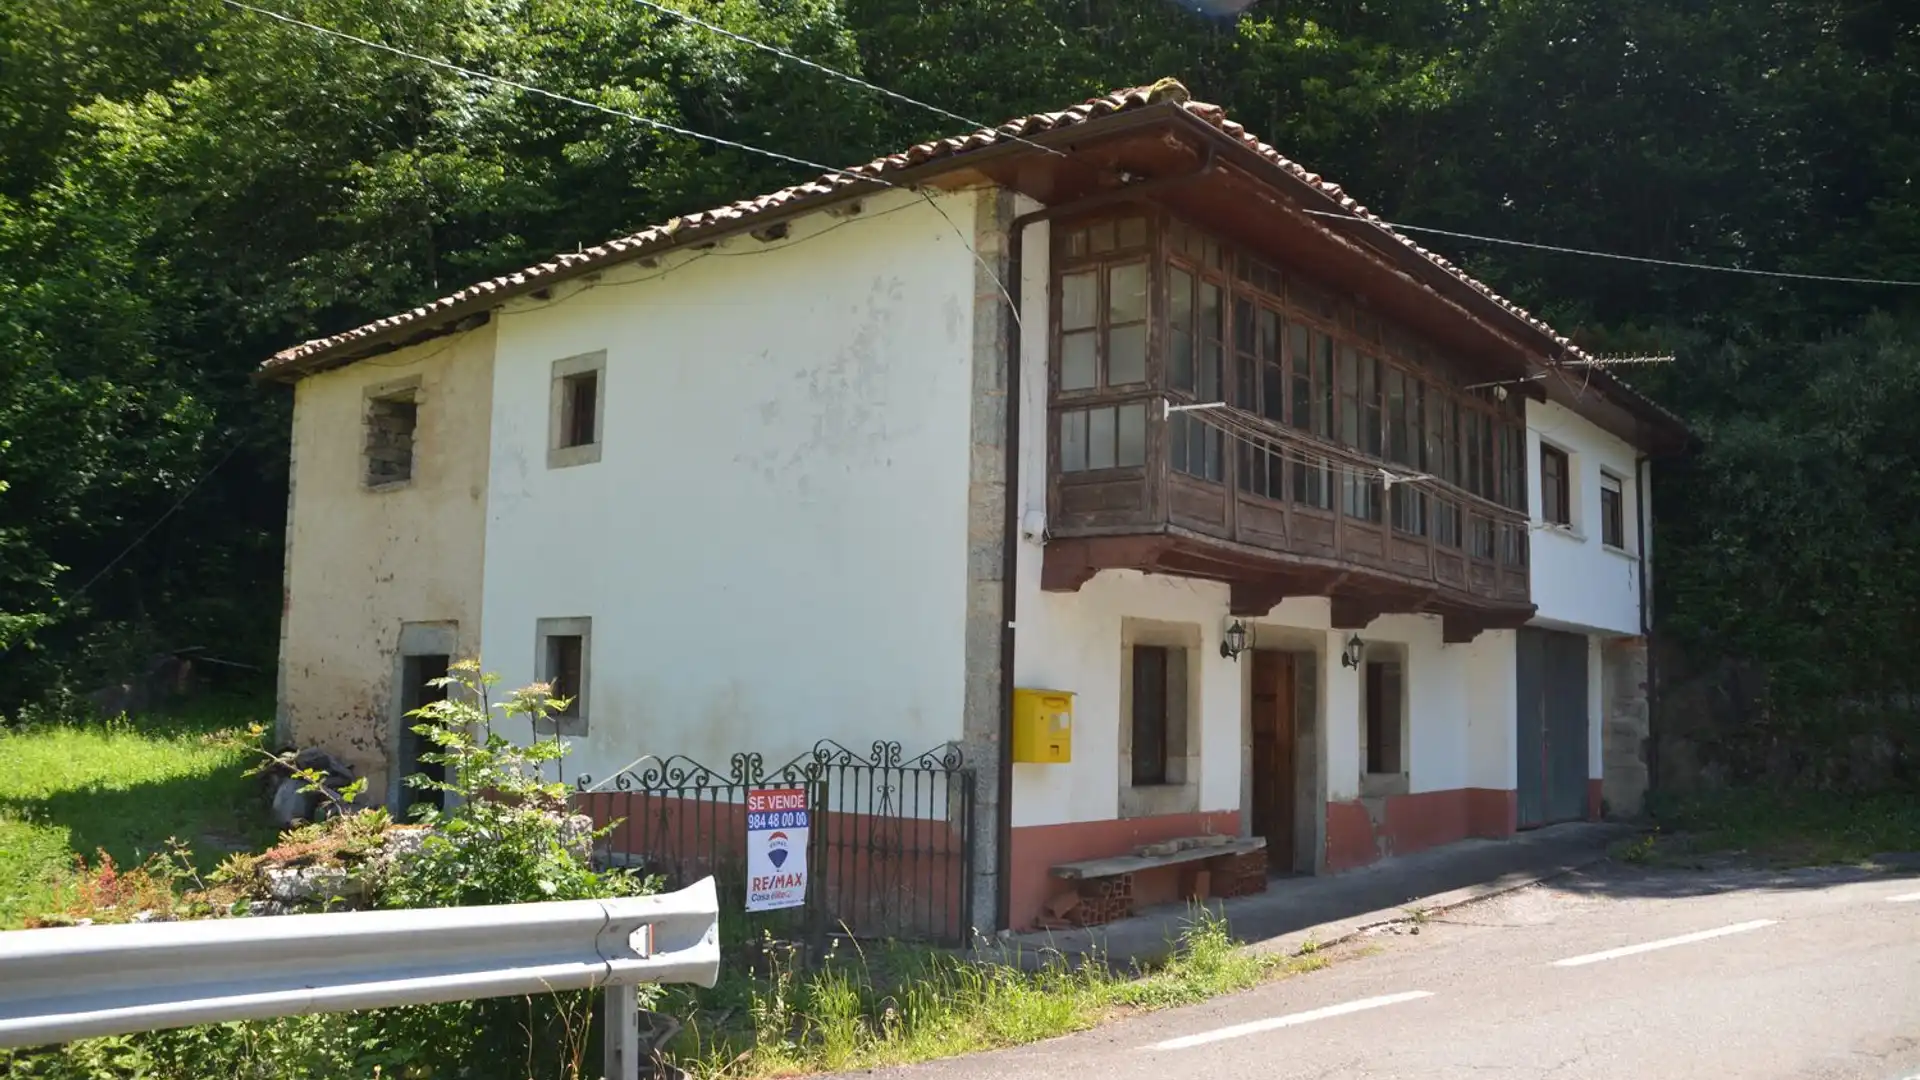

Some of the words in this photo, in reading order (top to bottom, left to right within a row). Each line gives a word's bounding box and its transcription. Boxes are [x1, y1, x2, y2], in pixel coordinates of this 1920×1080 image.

[749, 796, 765, 810] SE
[767, 794, 804, 809] VENDE
[748, 813, 766, 828] 984
[768, 813, 780, 828] 48
[781, 812, 794, 827] 00
[795, 811, 807, 826] 00
[752, 872, 803, 891] RE/MAX
